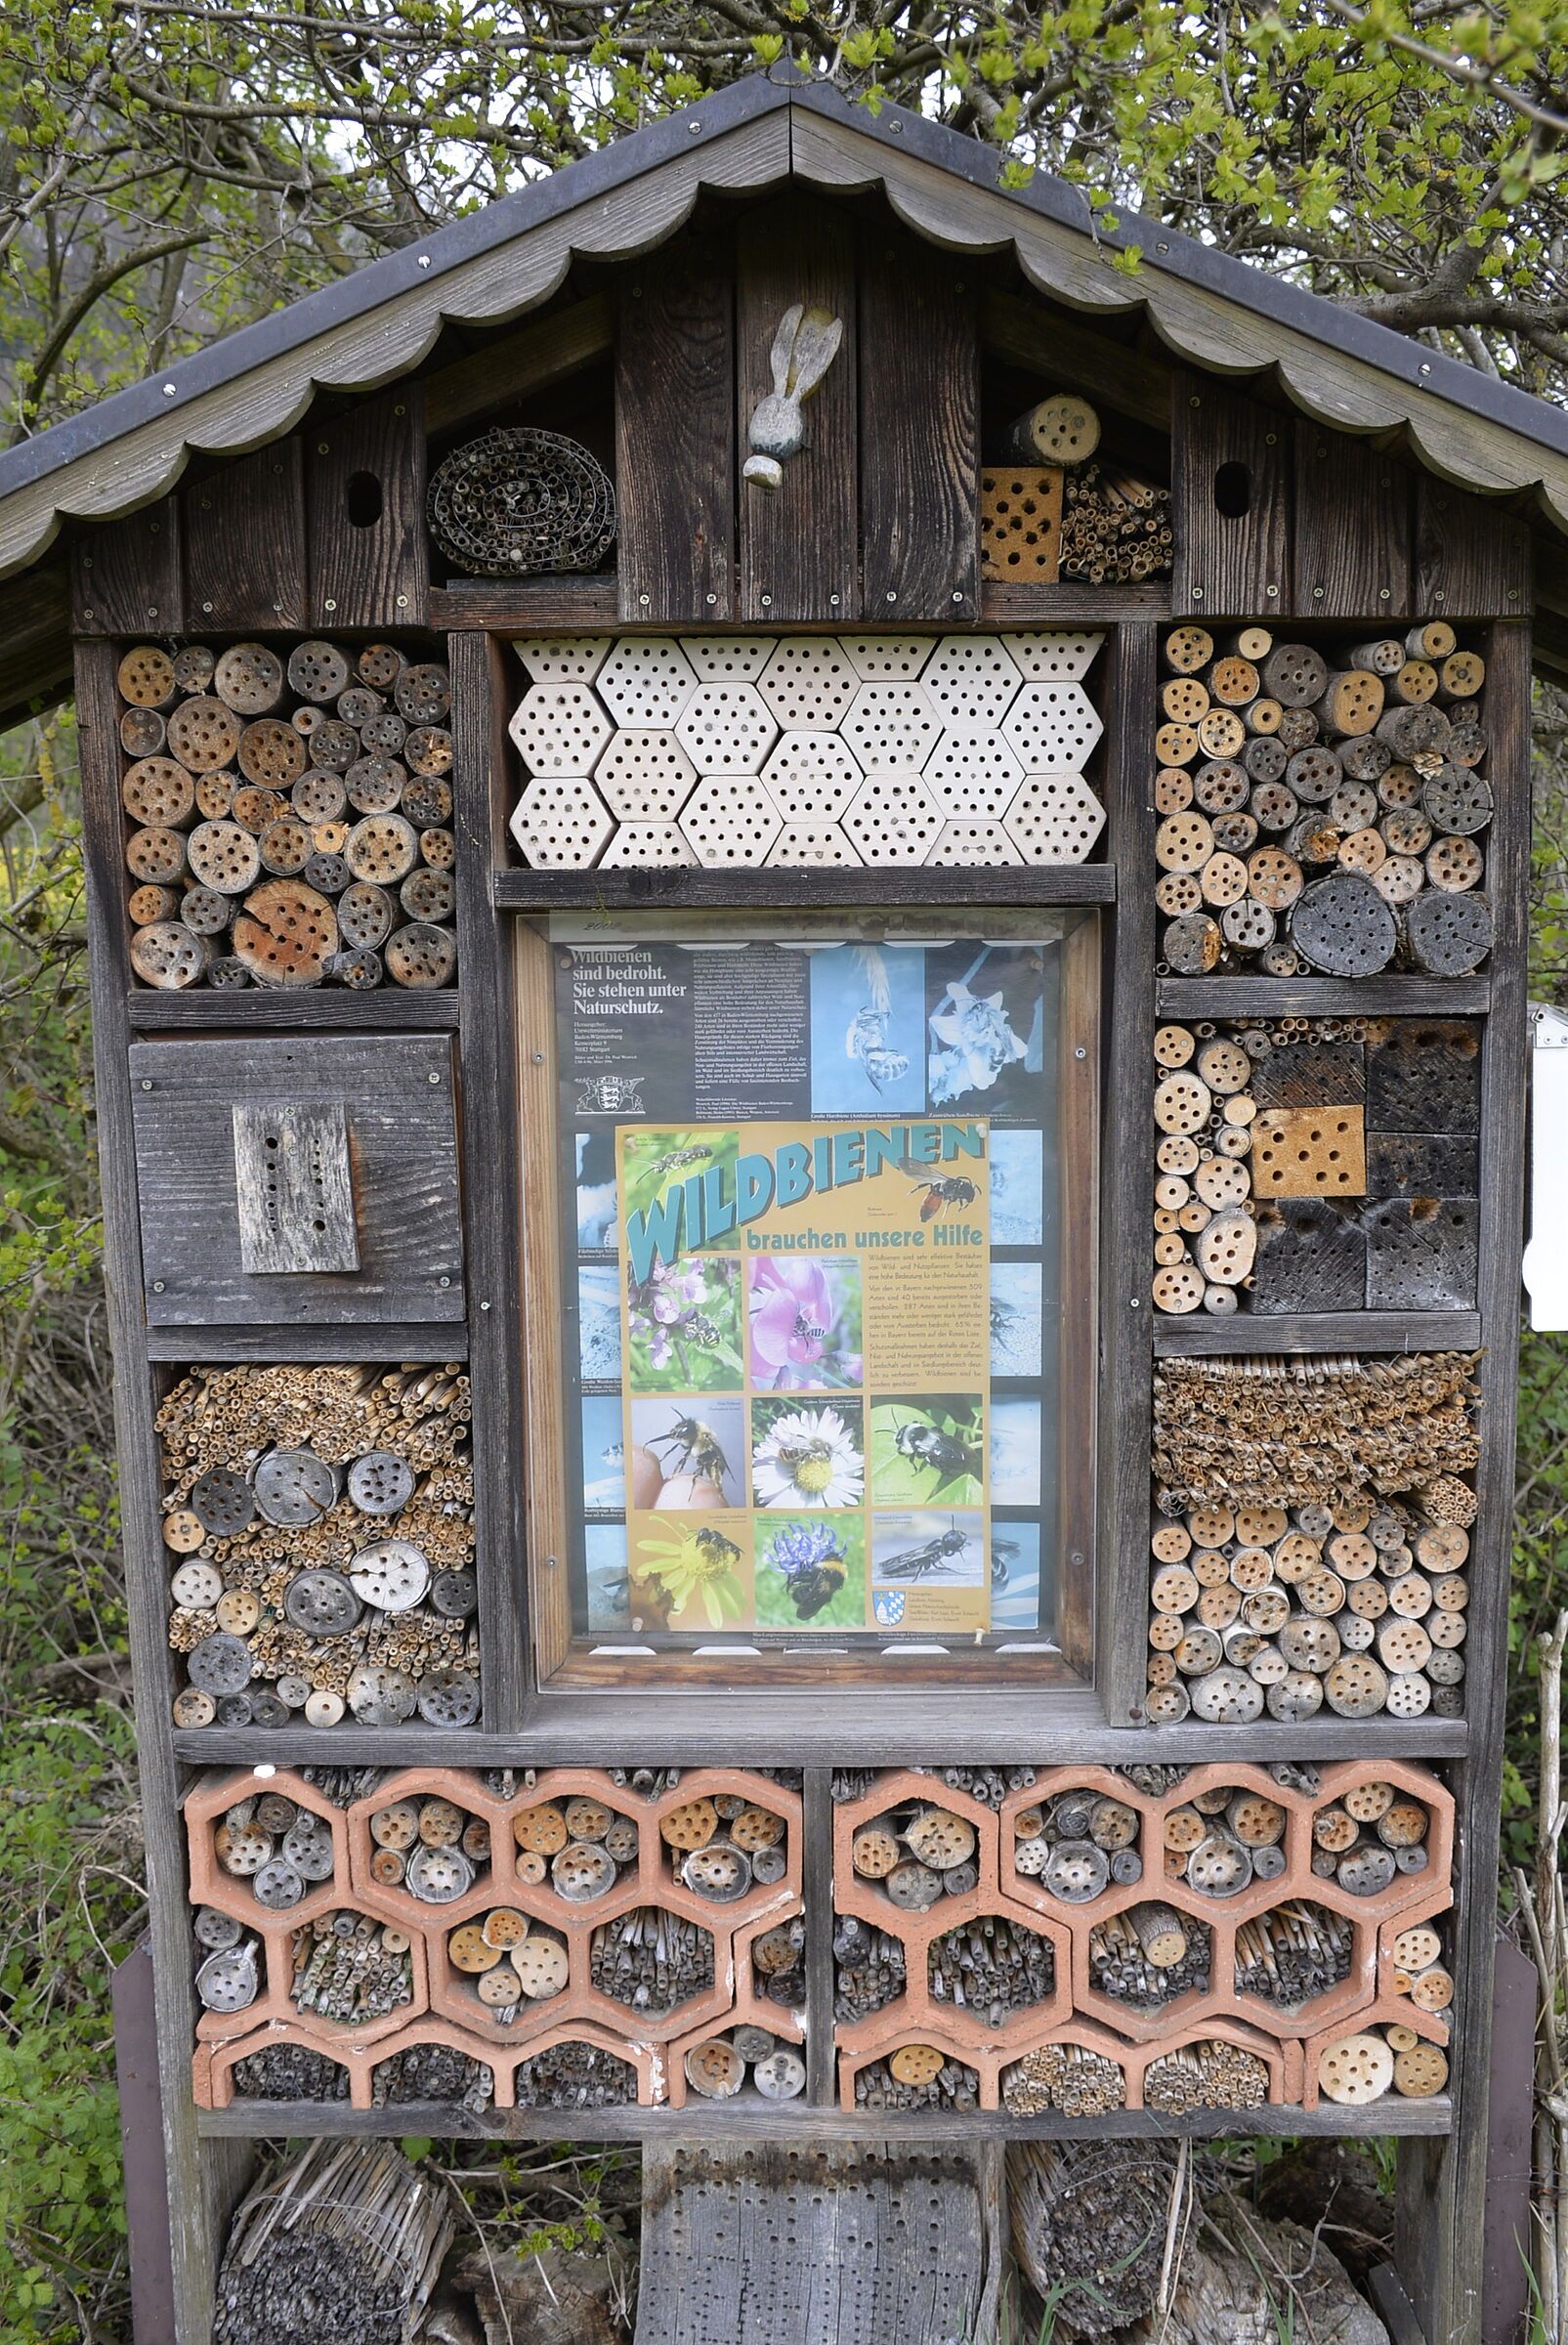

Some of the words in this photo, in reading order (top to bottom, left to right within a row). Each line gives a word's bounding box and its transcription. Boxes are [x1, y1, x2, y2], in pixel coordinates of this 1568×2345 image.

[572, 951, 652, 963] Wildbienen
[573, 965, 602, 980] sind
[606, 965, 666, 980] bedroht.
[573, 983, 595, 998] Sie
[598, 983, 645, 997] stehen
[649, 983, 687, 997] unter
[573, 1000, 663, 1014] Naturschutz.
[626, 1124, 985, 1287] WILDBIENEN
[747, 1227, 847, 1251] brauchen
[855, 1230, 924, 1249] unsere
[933, 1224, 983, 1247] Hilfe
